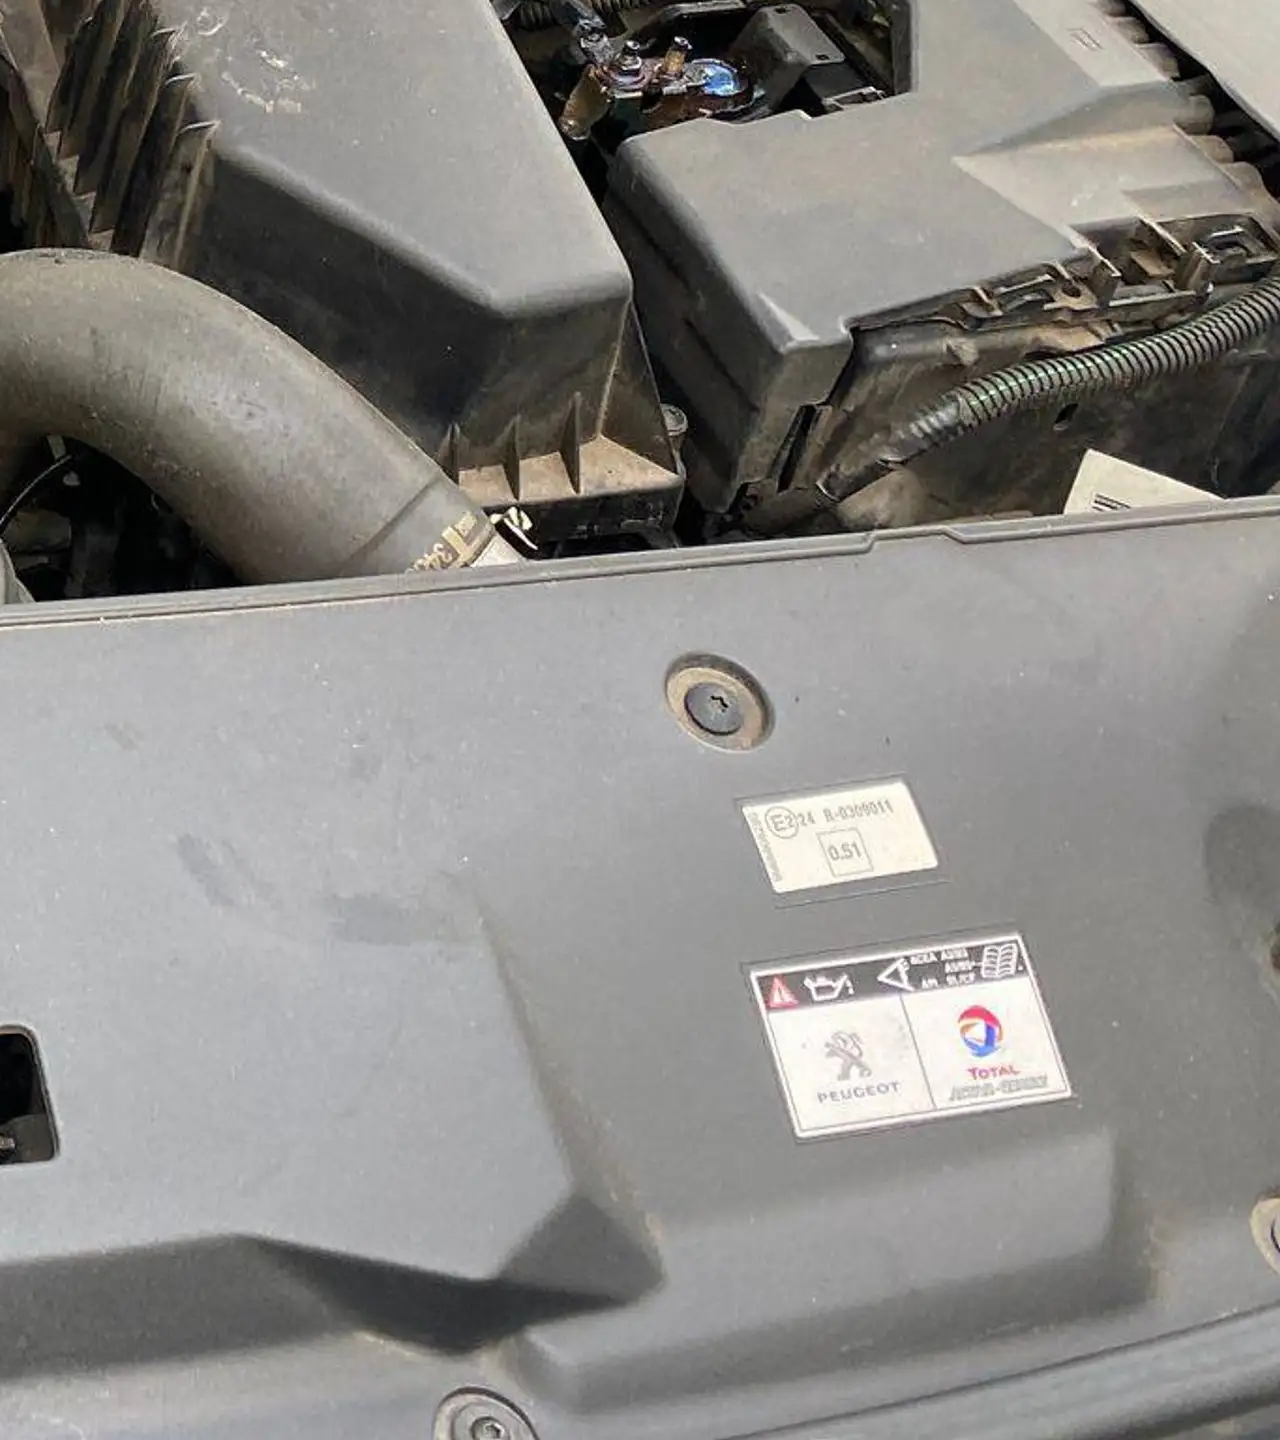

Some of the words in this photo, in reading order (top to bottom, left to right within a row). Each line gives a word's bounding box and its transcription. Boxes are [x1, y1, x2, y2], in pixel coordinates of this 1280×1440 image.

[827, 840, 863, 862] 0.51
[967, 1064, 1022, 1081] TOTAL
[816, 1082, 901, 1104] PEUGEOT
